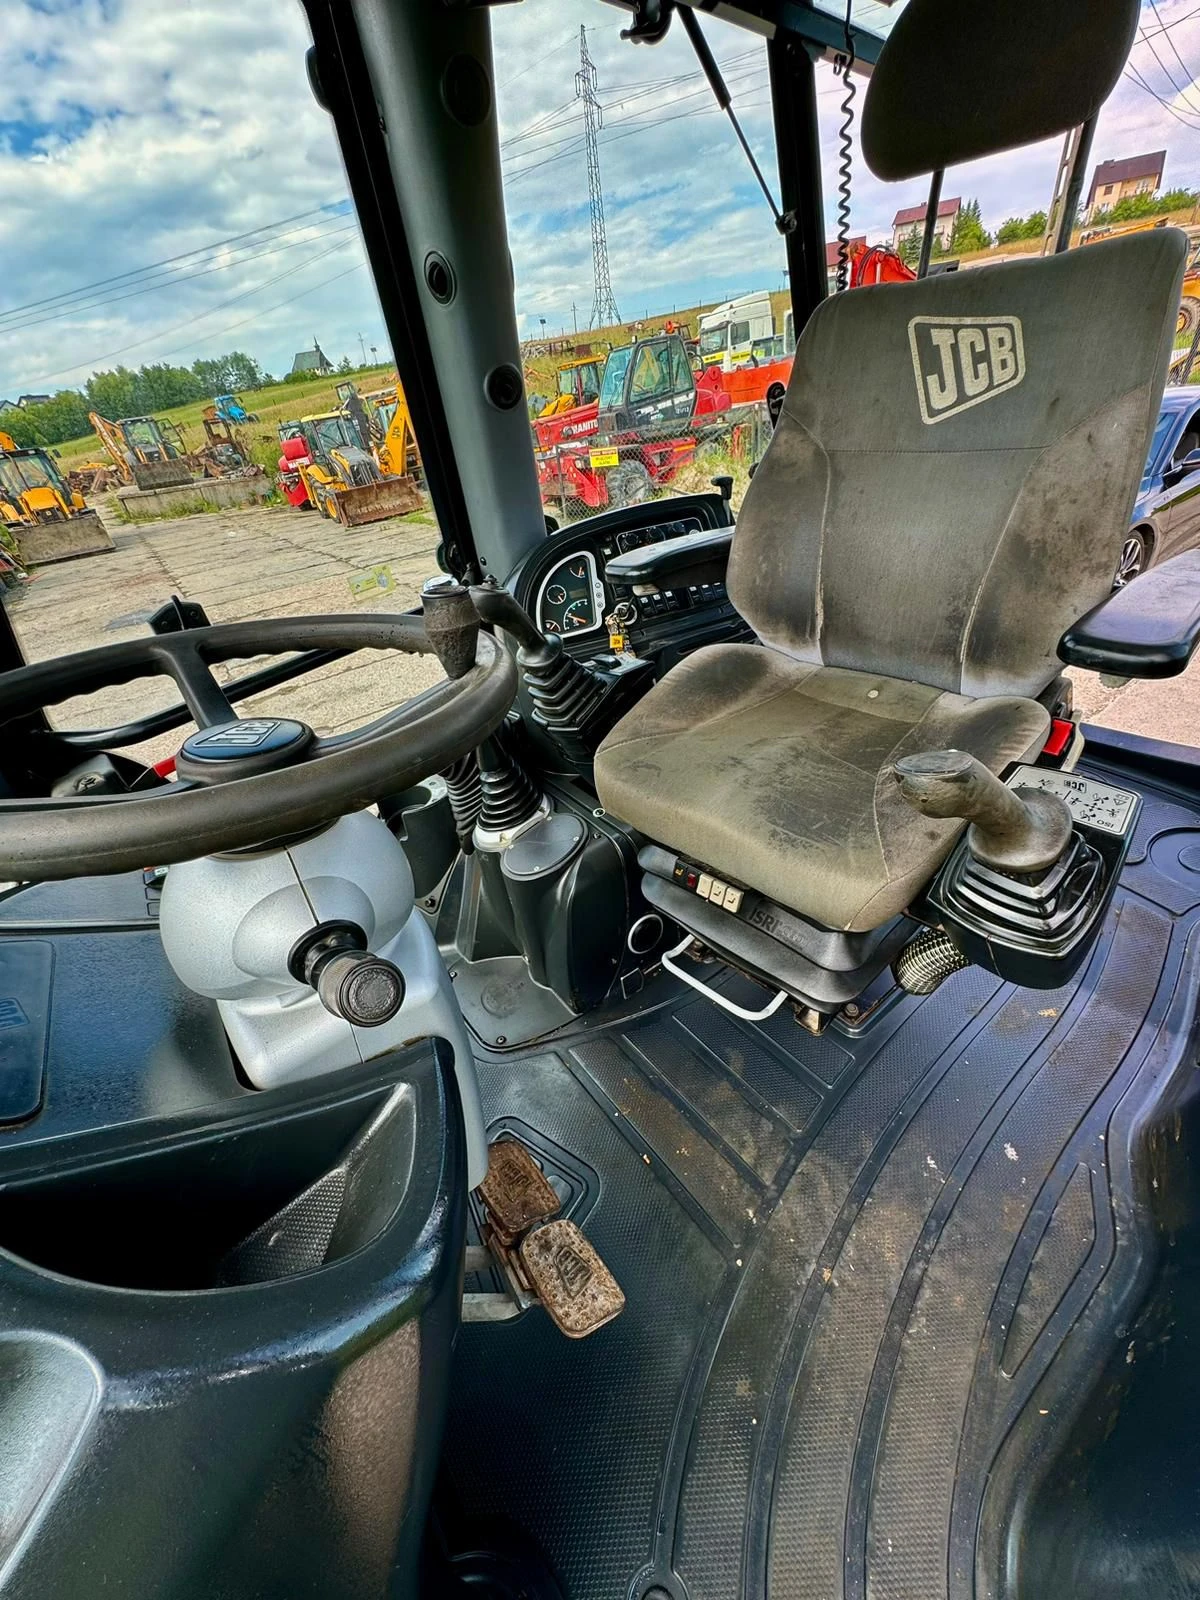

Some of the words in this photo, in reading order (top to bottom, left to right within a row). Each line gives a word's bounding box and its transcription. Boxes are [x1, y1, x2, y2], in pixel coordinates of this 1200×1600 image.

[926, 327, 1016, 410] JCB
[208, 721, 275, 745] JCB
[1066, 780, 1085, 791] JCB
[1096, 819, 1114, 828] ISO
